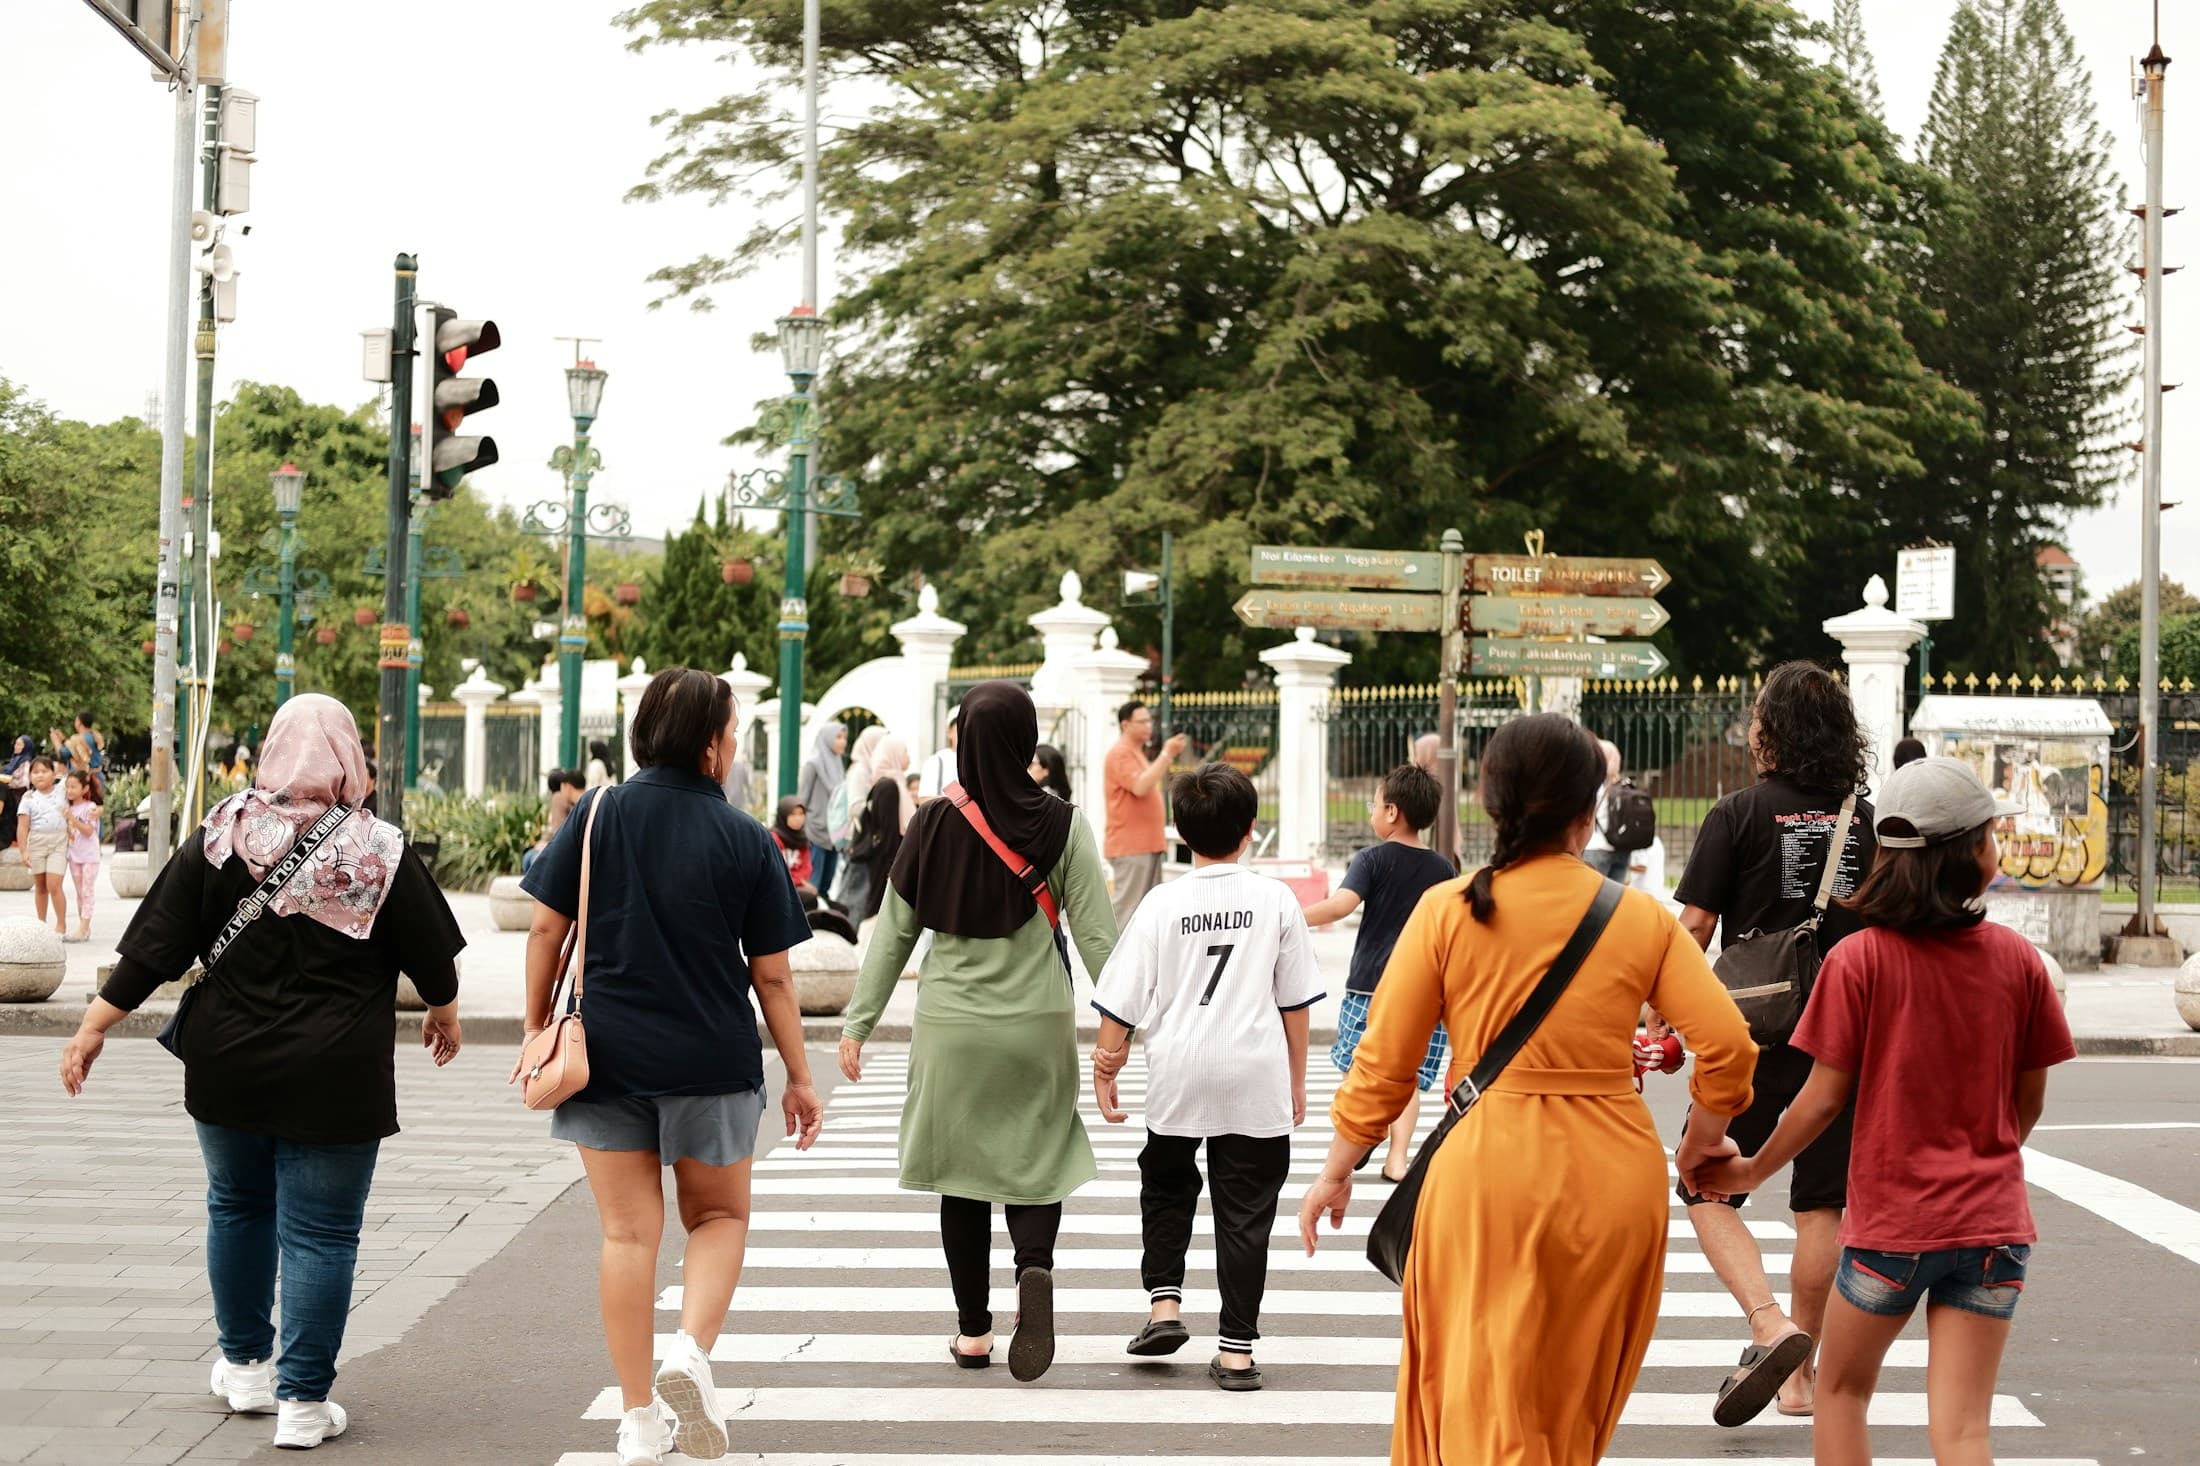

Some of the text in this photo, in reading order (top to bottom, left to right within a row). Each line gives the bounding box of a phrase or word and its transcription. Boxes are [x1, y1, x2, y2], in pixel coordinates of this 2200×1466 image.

[1490, 566, 1543, 583] TOILET
[1775, 813, 1801, 823] Rock
[268, 851, 303, 887] LOLA
[1181, 910, 1253, 935] RONALDO
[1198, 944, 1235, 1006] 7
